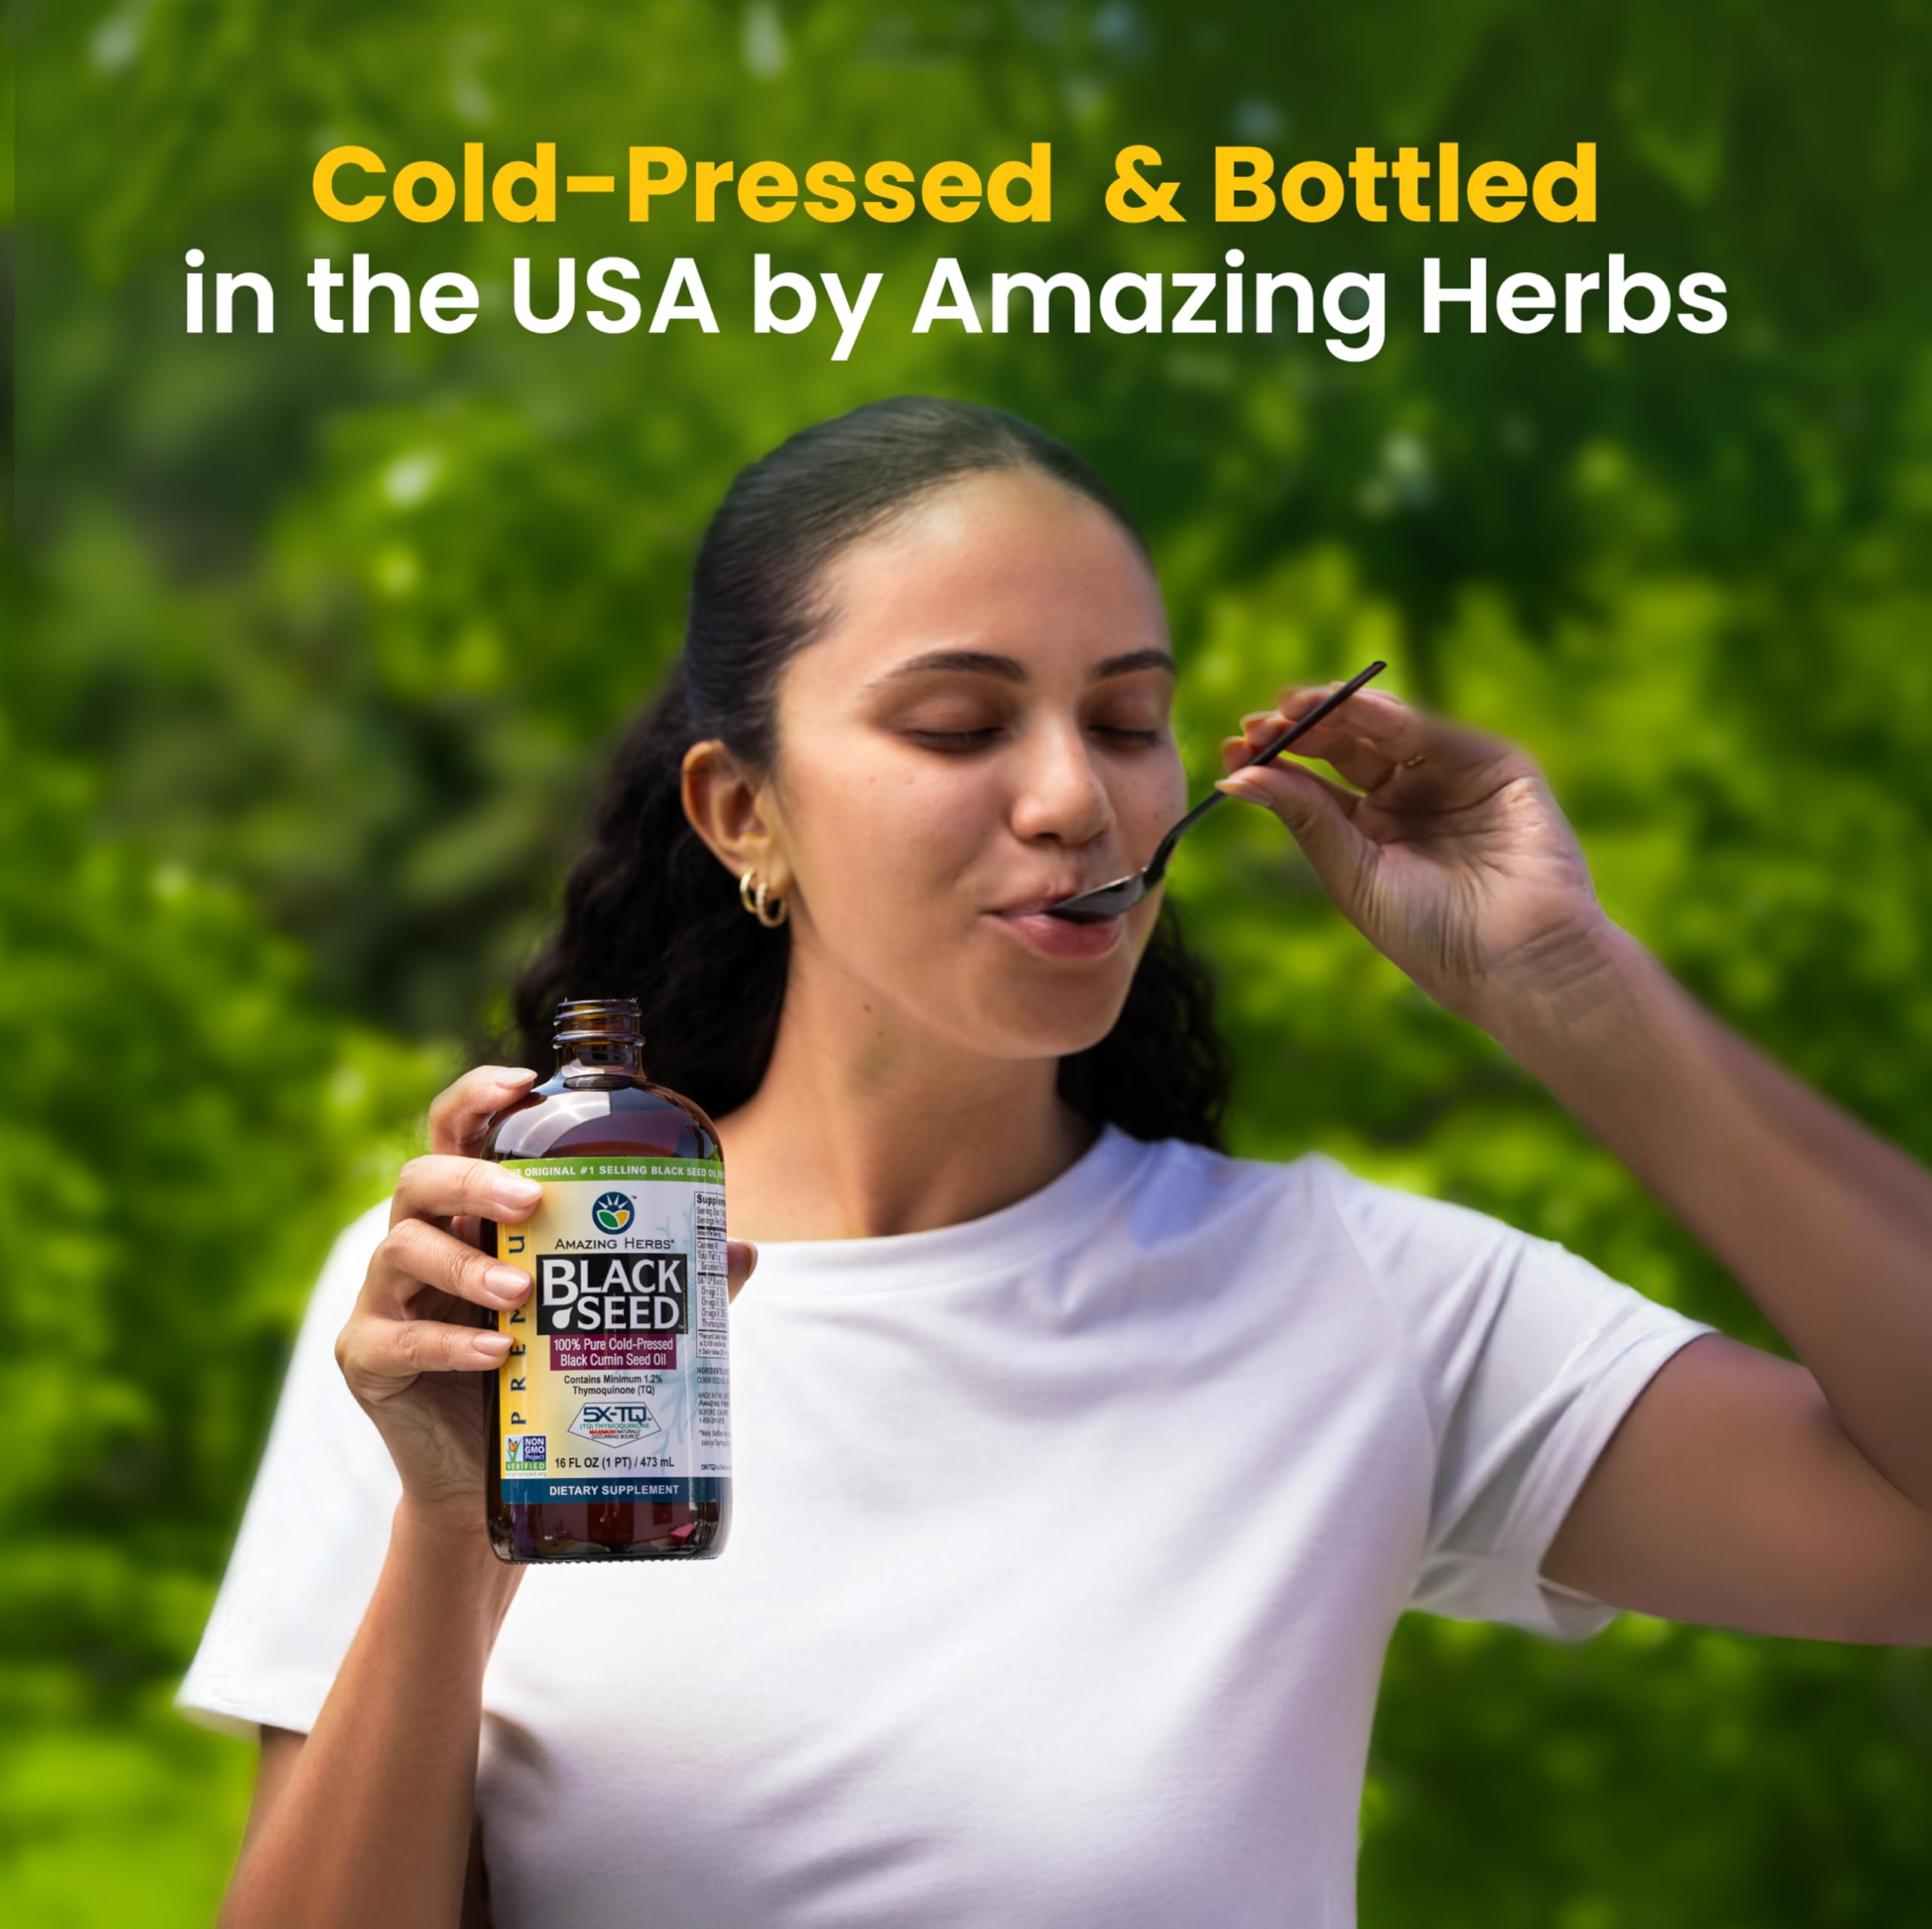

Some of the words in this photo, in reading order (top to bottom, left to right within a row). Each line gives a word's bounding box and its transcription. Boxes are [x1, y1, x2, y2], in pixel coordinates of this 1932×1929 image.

[525, 1166, 576, 1177] ORIGINAL
[580, 1165, 594, 1175] #1
[599, 1165, 647, 1175] SELLING
[651, 1166, 685, 1176] BLACK
[686, 1168, 706, 1177] SEED
[554, 1238, 617, 1250] AMAZING
[542, 1259, 683, 1306] BLACK
[577, 1295, 679, 1330] SEED
[553, 1338, 581, 1351] 100%
[583, 1338, 606, 1350] Pure
[608, 1337, 673, 1350] Cold-Pressed
[560, 1354, 588, 1367] Black
[589, 1354, 623, 1366] Cumin
[626, 1353, 651, 1366] Seed
[653, 1353, 666, 1365] Oil
[564, 1375, 601, 1384] Contains
[603, 1375, 641, 1383] Minimum
[644, 1374, 663, 1383] 1.2%
[572, 1386, 635, 1396] Thymoquinone
[637, 1385, 656, 1396] (TQ)
[583, 1406, 647, 1424] 5X-TQ
[525, 1437, 544, 1446] NON
[525, 1445, 545, 1454] GMO
[555, 1458, 566, 1468] 16
[568, 1458, 581, 1468] FL
[584, 1458, 599, 1468] OZ
[601, 1457, 611, 1470] (1
[615, 1457, 632, 1469] PT)
[640, 1458, 658, 1468] 473
[660, 1457, 675, 1467] mL
[549, 1486, 599, 1496] DIETARY
[601, 1484, 679, 1495] SUPPLEMENT
